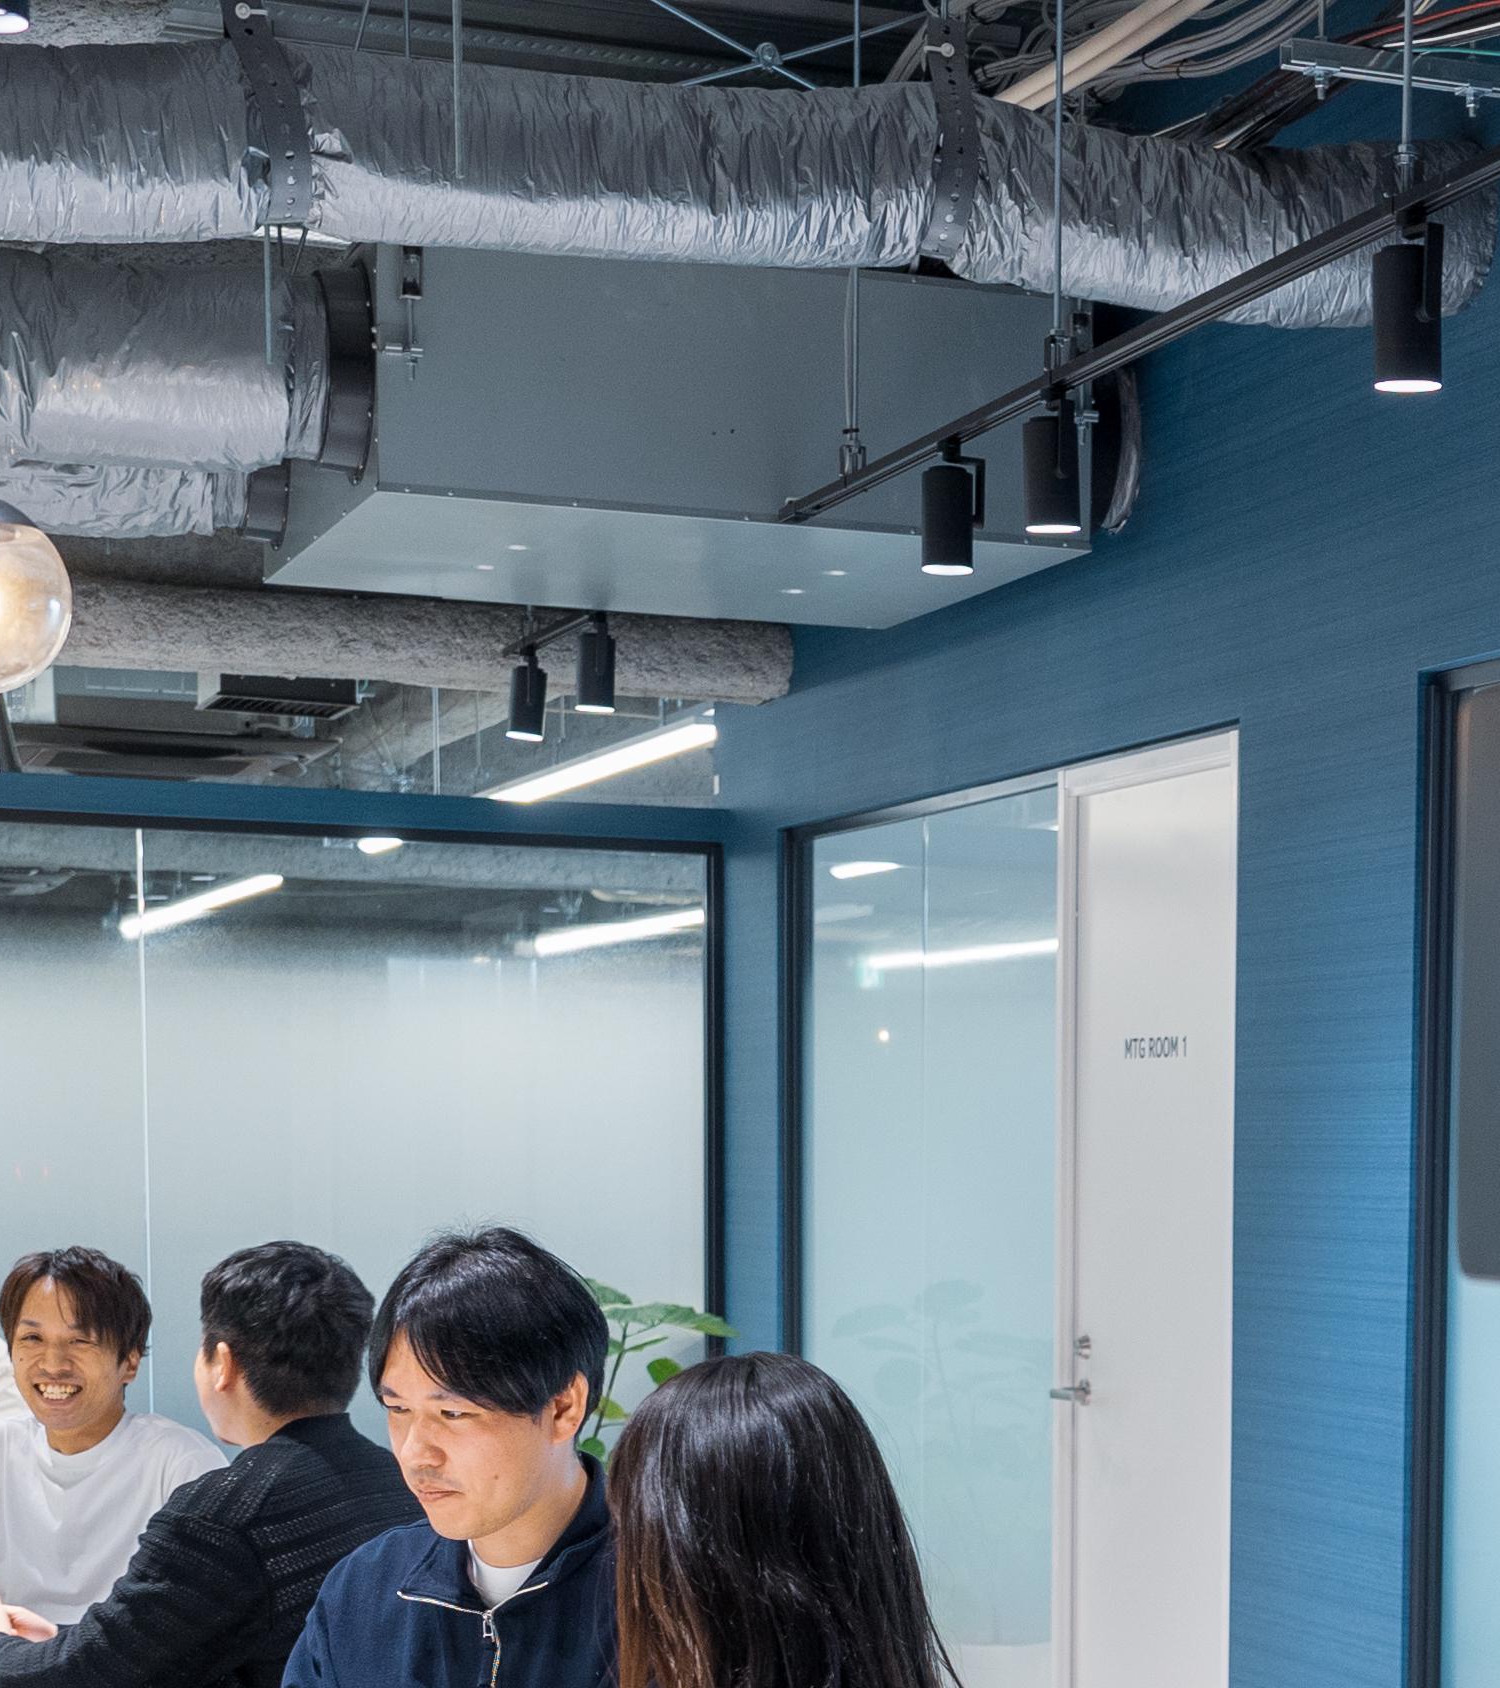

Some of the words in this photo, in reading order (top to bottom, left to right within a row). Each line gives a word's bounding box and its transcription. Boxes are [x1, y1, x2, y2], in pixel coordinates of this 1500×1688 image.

[1124, 1037, 1146, 1060] MTG
[1148, 1036, 1179, 1059] ROOM
[1181, 1035, 1188, 1057] 1
